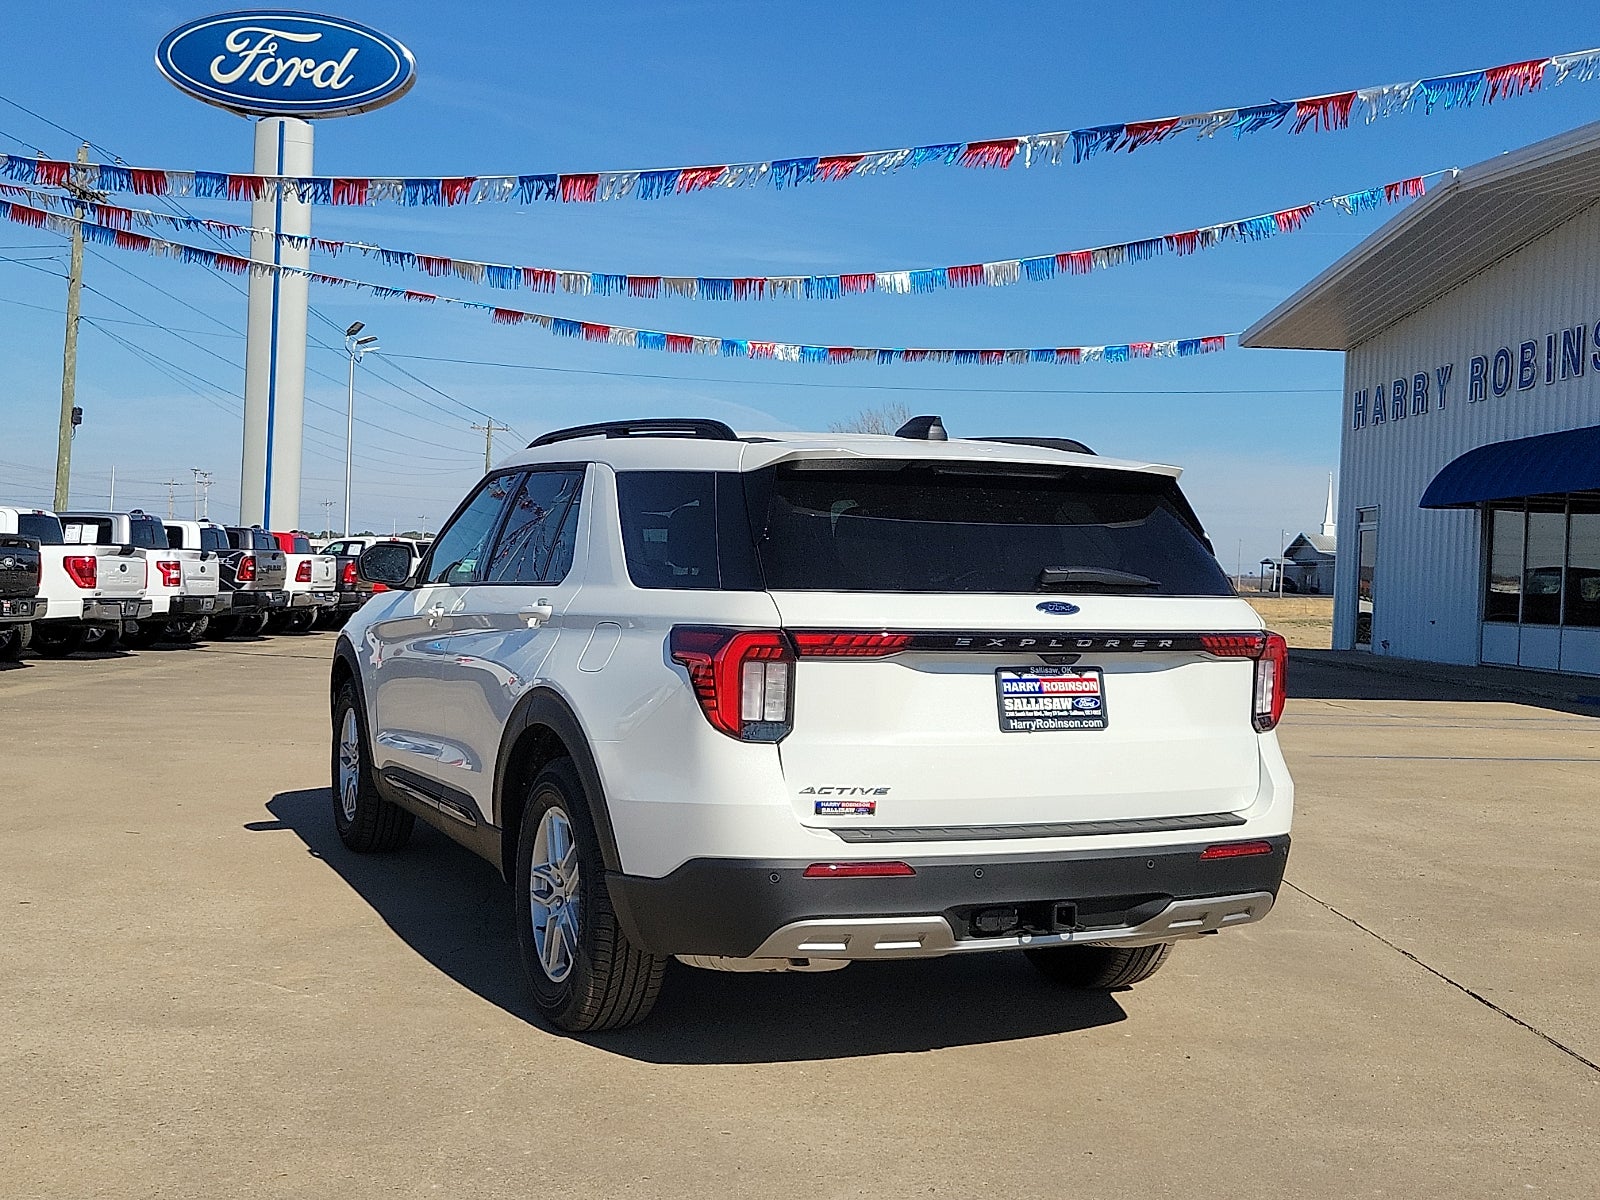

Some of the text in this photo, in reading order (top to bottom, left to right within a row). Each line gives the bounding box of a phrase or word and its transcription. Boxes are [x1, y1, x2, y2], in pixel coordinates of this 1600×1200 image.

[210, 27, 360, 90] Ford
[1353, 363, 1453, 430] HARRY
[1047, 602, 1073, 611] Ford
[955, 638, 1173, 648] EXPLORER
[1030, 666, 1060, 675] Sallisaw,
[1003, 681, 1098, 693] HARRY ROBINSON
[1004, 697, 1073, 711] SALLISAW
[1010, 719, 1104, 730] HarryRobinson.com
[799, 786, 892, 795] ACTIVE
